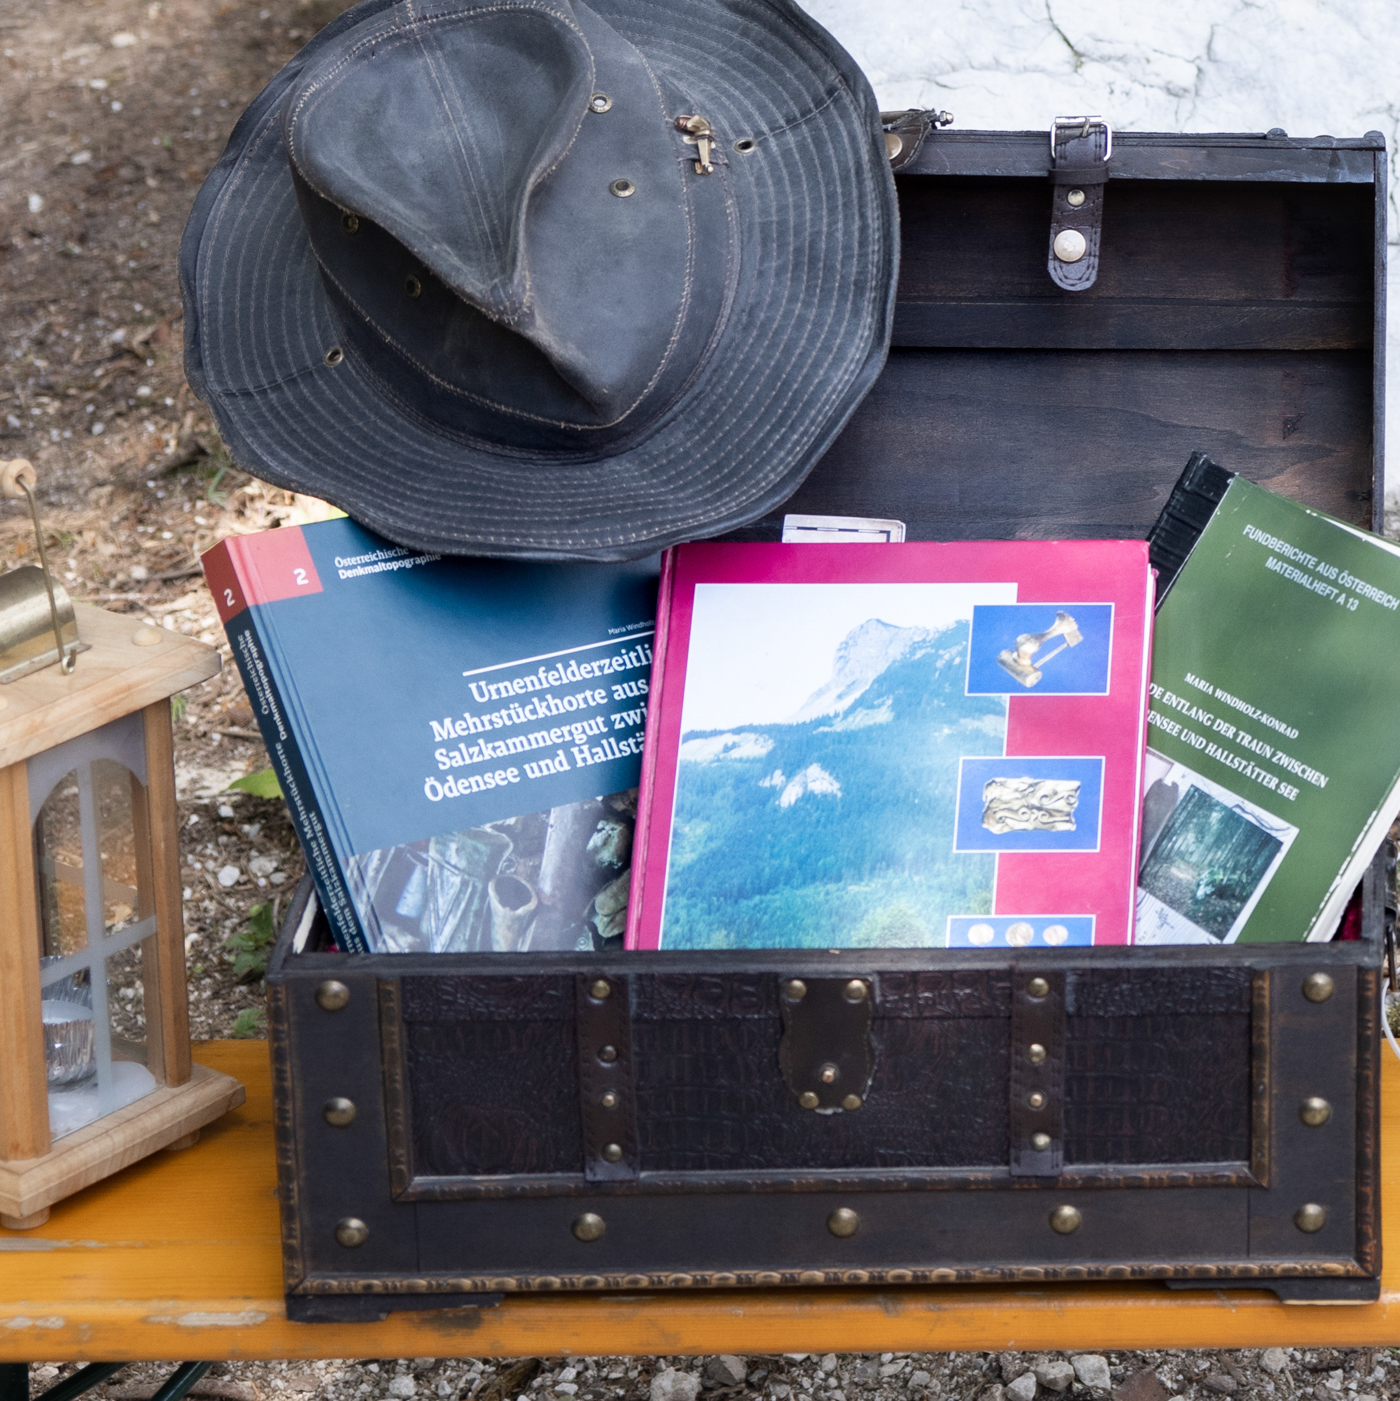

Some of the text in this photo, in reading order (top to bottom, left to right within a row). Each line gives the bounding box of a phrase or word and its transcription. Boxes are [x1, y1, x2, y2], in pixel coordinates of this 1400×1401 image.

[293, 568, 309, 586] 2
[334, 547, 409, 568] Österreichische
[338, 553, 441, 579] Denkmaltopographie
[1242, 524, 1400, 611] FUNDBERICHTE AUS ÖSTERREICH
[1265, 556, 1359, 612] MATERIALHEFT A 13
[223, 589, 235, 607] 2
[608, 626, 626, 635] Maria
[238, 634, 269, 715] Österreichische
[244, 629, 287, 740] Denkmaltopographie
[468, 643, 653, 703] Urnenfelderzeitli
[1184, 672, 1300, 740] MARIA WINDHOLZ-KONRAD
[429, 678, 650, 742] Mehrstückhorte aus
[434, 701, 648, 770] Salzkammergut zwi
[1149, 682, 1329, 789] DE ENTLANG DER TRAUN ZWISCHEN
[424, 731, 645, 801] Ödensee und Hallstä
[1147, 709, 1300, 801] ENSEE UND HALLSTÄTTER SEE
[275, 742, 355, 955] rnenfelderzeitliche Mehrstückhorte
[308, 811, 346, 906] Salzkammergut
